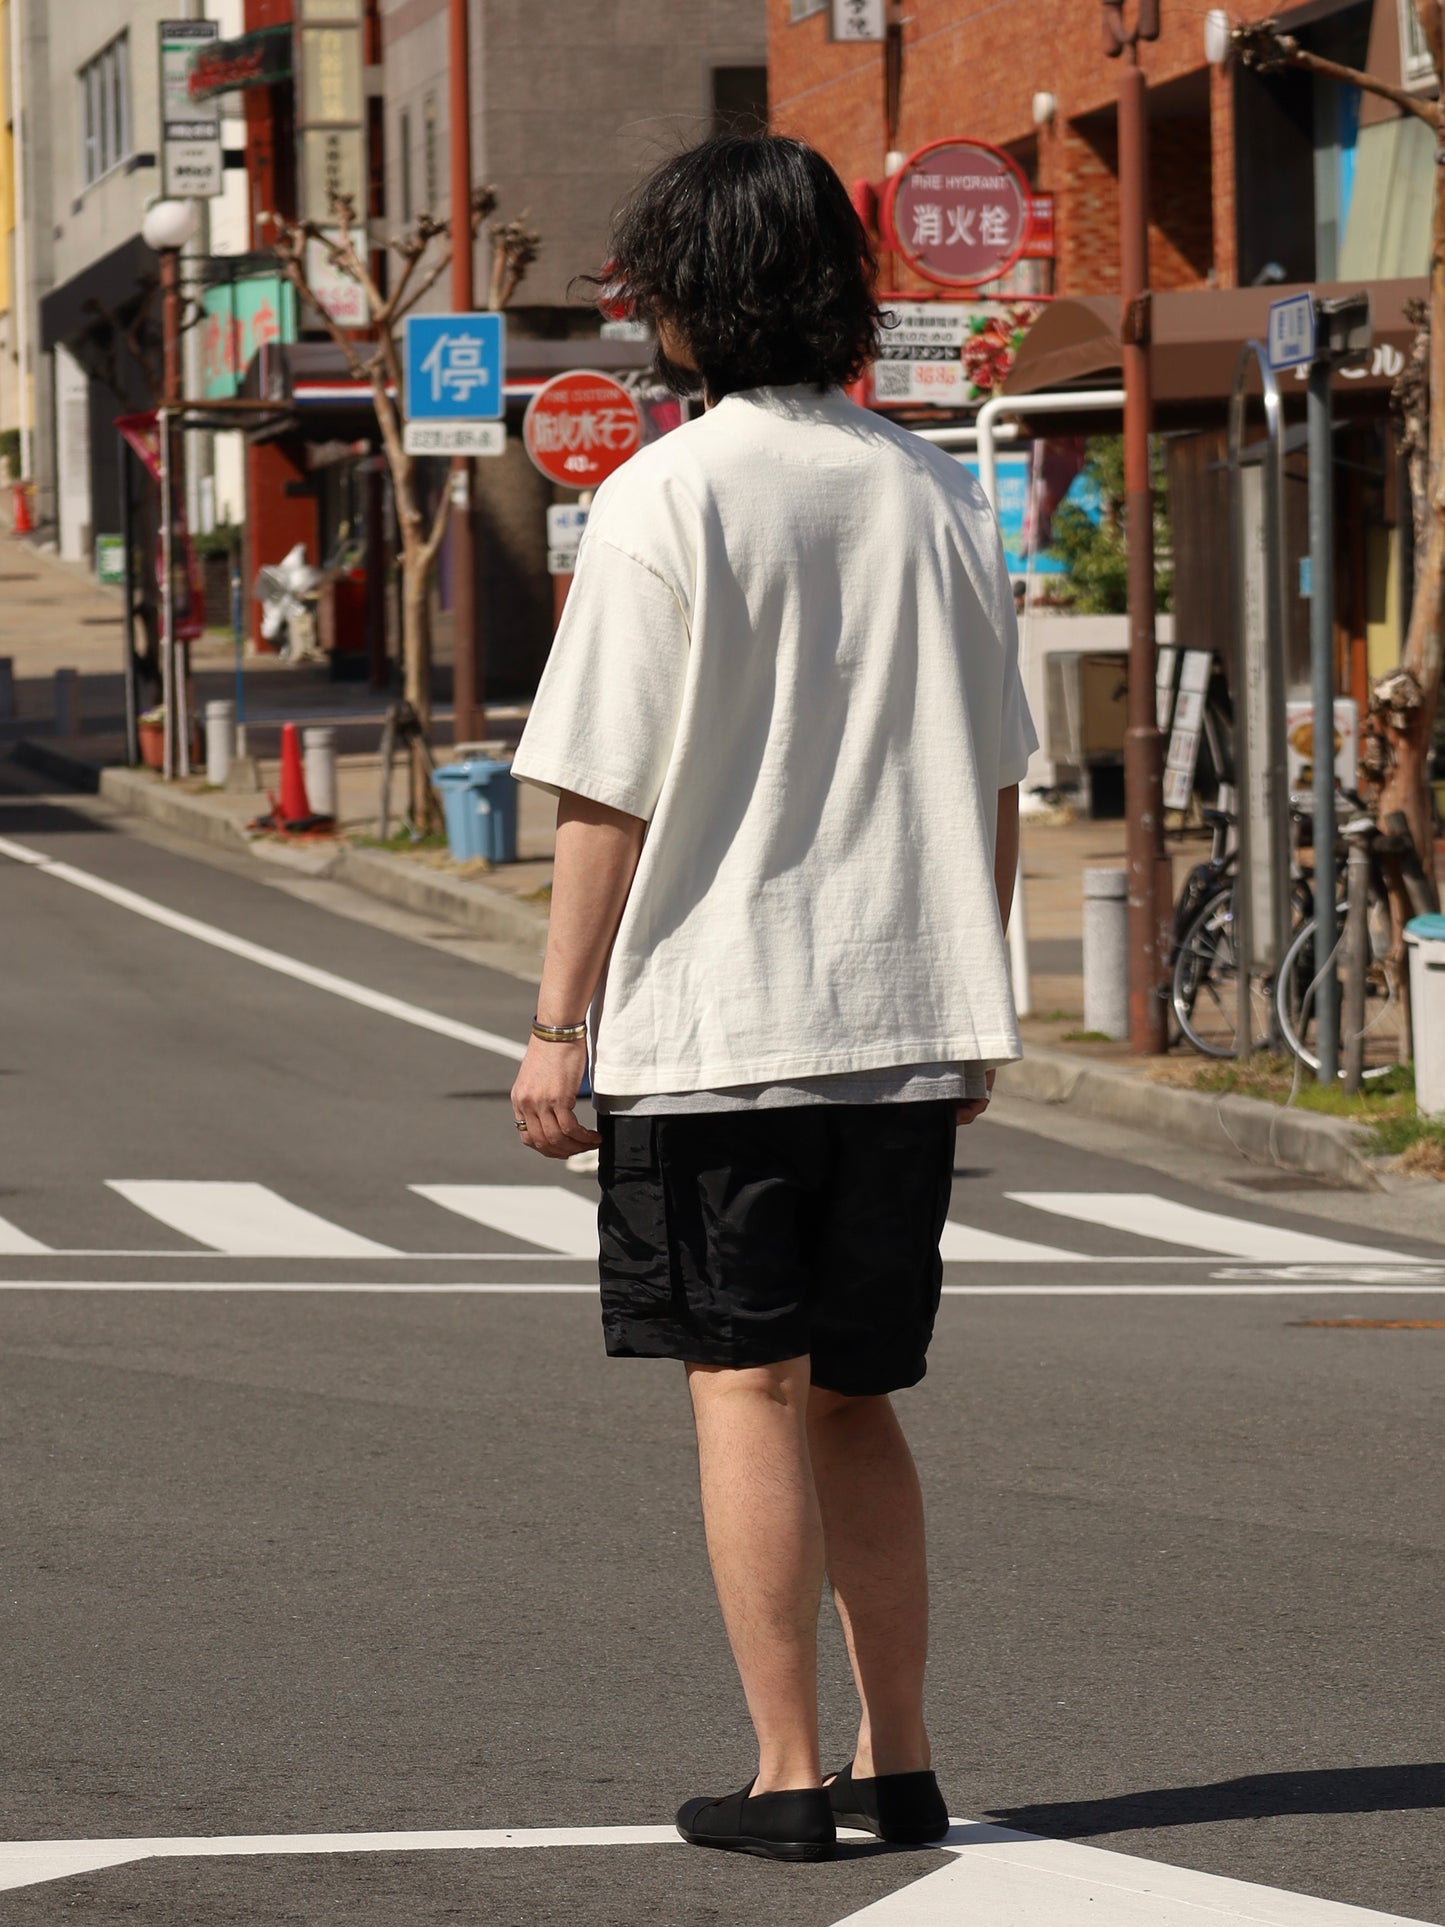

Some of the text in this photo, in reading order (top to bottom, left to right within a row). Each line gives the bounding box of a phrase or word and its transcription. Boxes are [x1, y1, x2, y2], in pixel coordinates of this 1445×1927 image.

[911, 174, 1007, 191] FIRE HYDRANT
[911, 203, 1011, 246] 消火栓
[420, 333, 488, 401] 停
